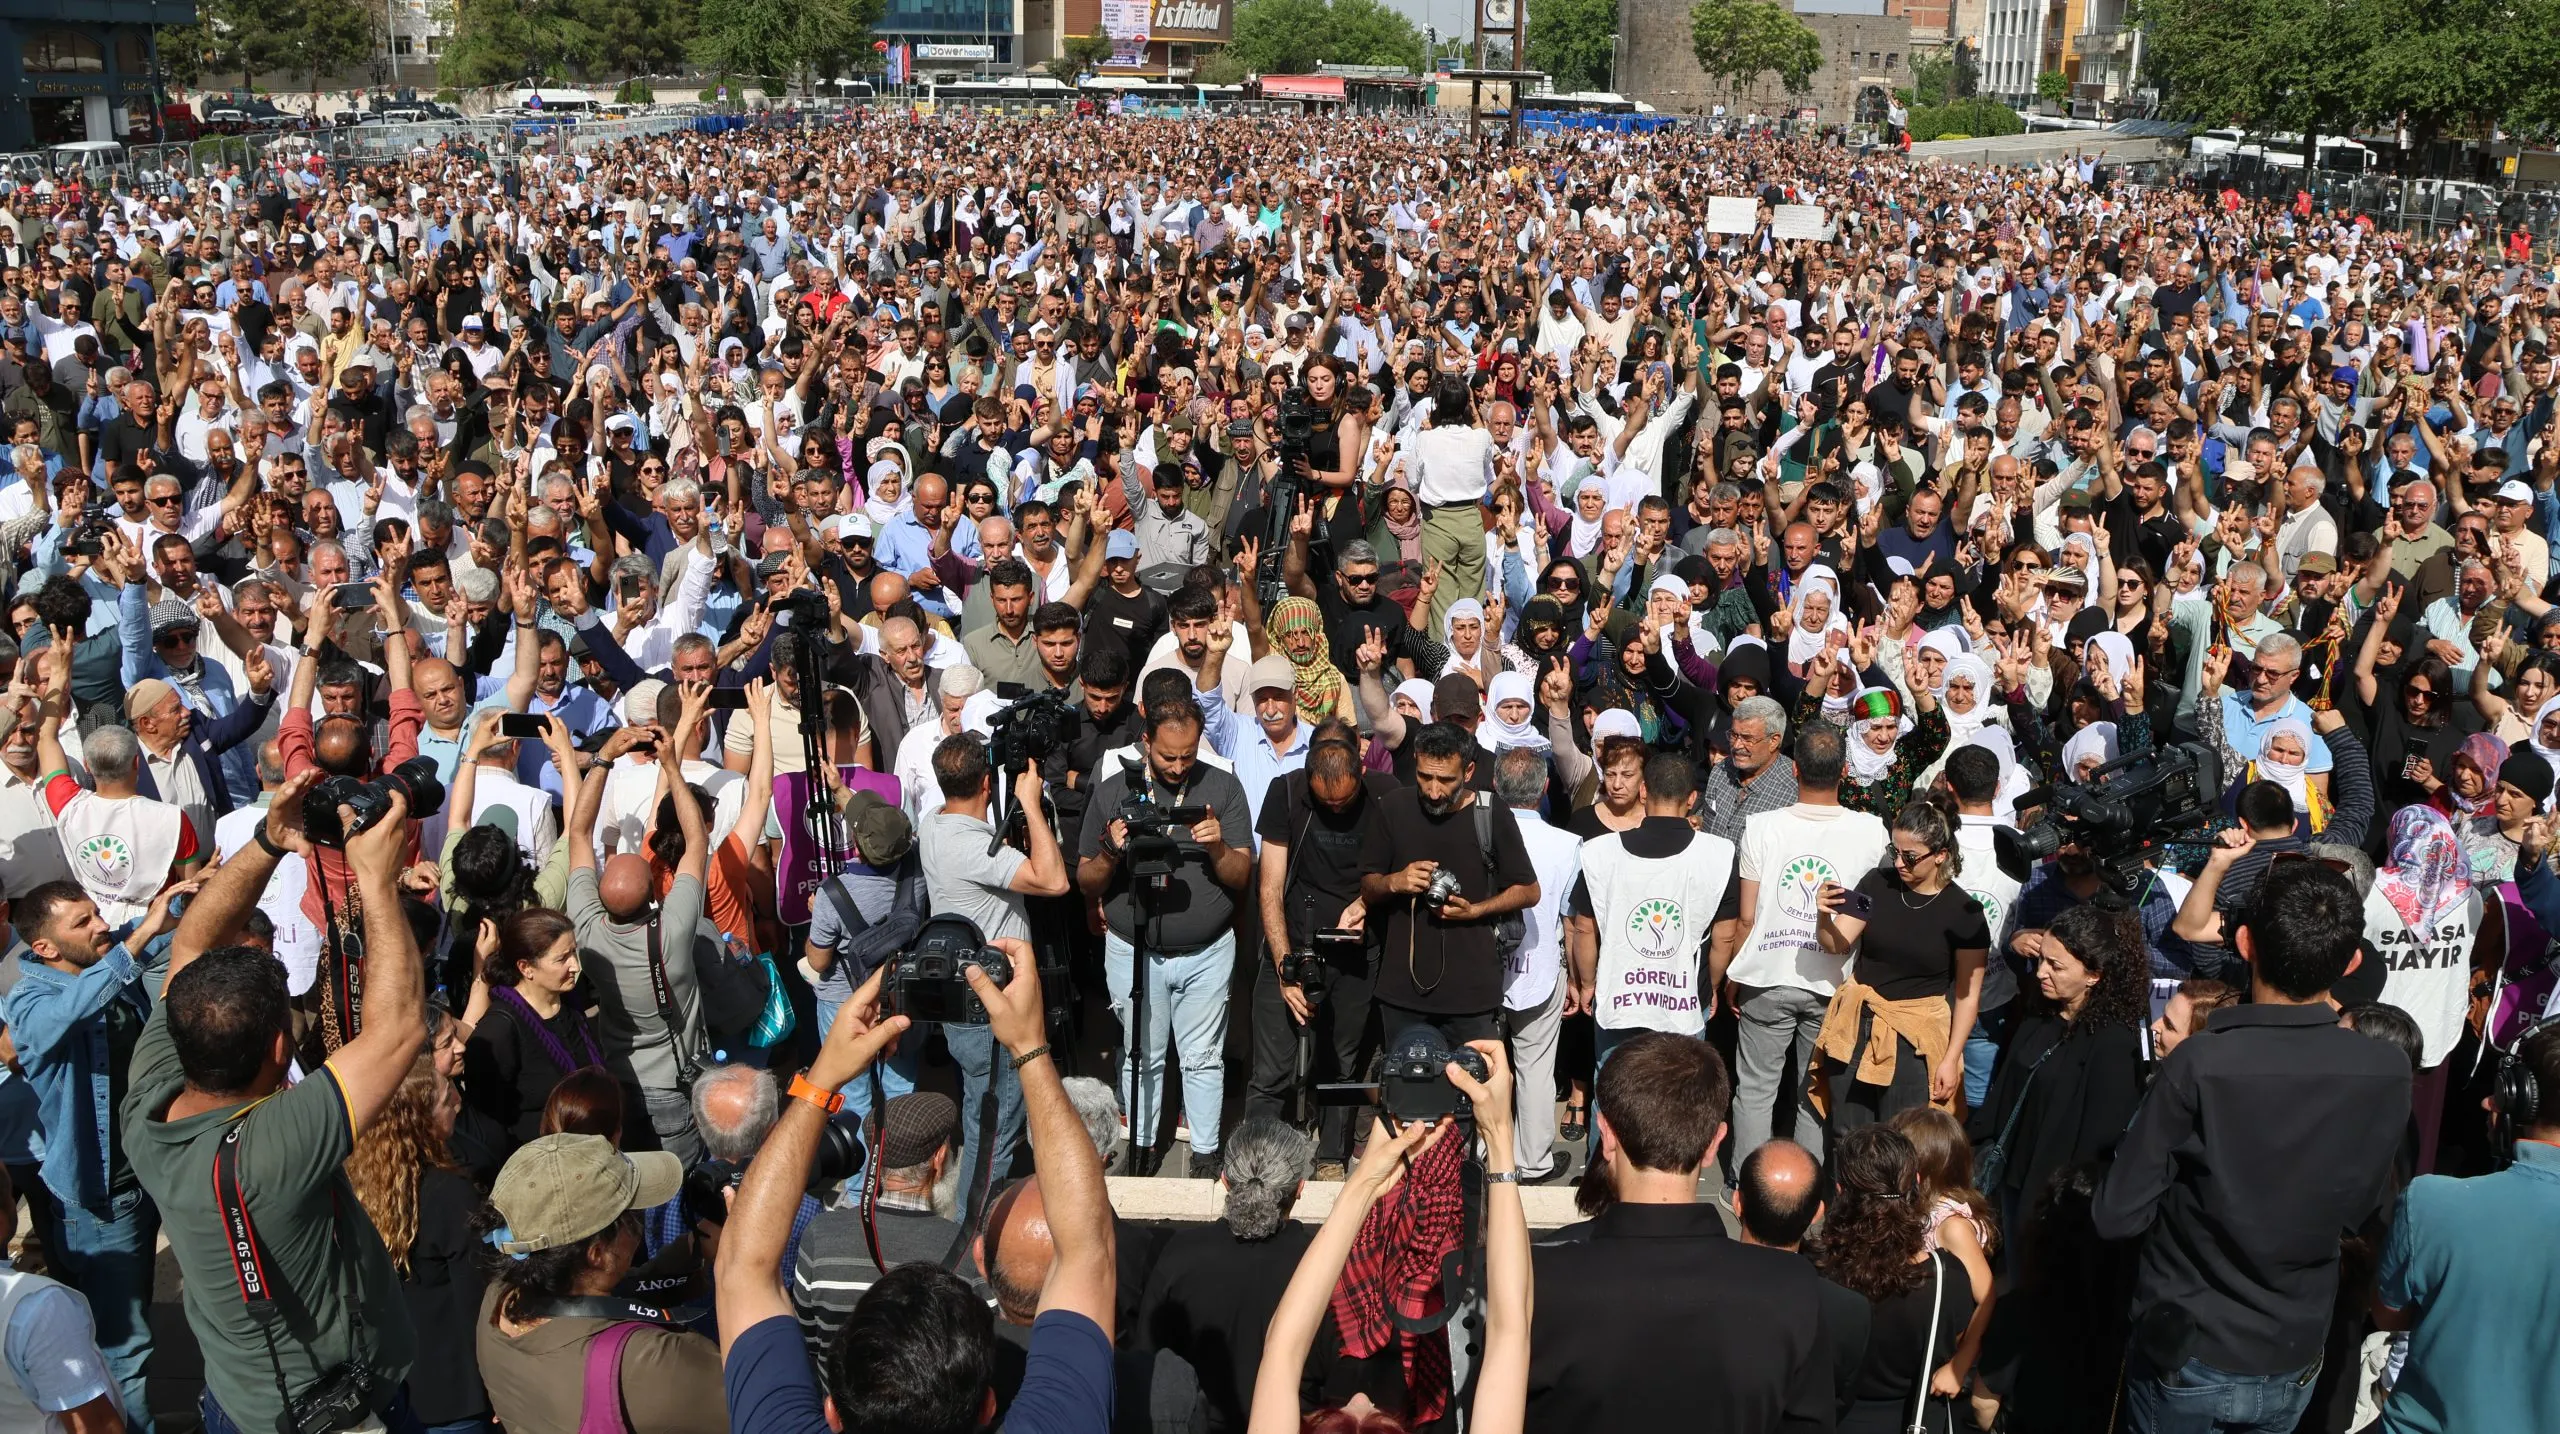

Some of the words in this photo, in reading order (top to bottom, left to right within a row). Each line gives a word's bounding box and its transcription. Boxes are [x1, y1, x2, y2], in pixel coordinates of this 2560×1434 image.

[1154, 0, 1221, 30] istikbal
[1786, 906, 1803, 918] DEM
[1763, 928, 1811, 940] HALKLARIN
[2380, 923, 2466, 946] SAAŞA
[1640, 946, 1656, 957] DEM
[1757, 943, 1769, 952] VE
[1769, 939, 1818, 952] DEMOKRASİ
[2379, 944, 2462, 972] HAYIR
[349, 963, 361, 995] EOS
[654, 962, 664, 989] DIGITAL
[1624, 967, 1687, 989] GÖREVLİ
[351, 997, 362, 1013] 5D
[658, 990, 667, 1004] EOS
[1613, 992, 1698, 1011] PEYWIRDAR
[870, 1144, 879, 1176] EOS
[866, 1176, 876, 1194] R6
[230, 1207, 239, 1217] IV
[233, 1216, 246, 1238] Mark
[237, 1241, 251, 1258] 5D
[242, 1260, 261, 1294] EOS
[635, 1276, 688, 1292] SONY
